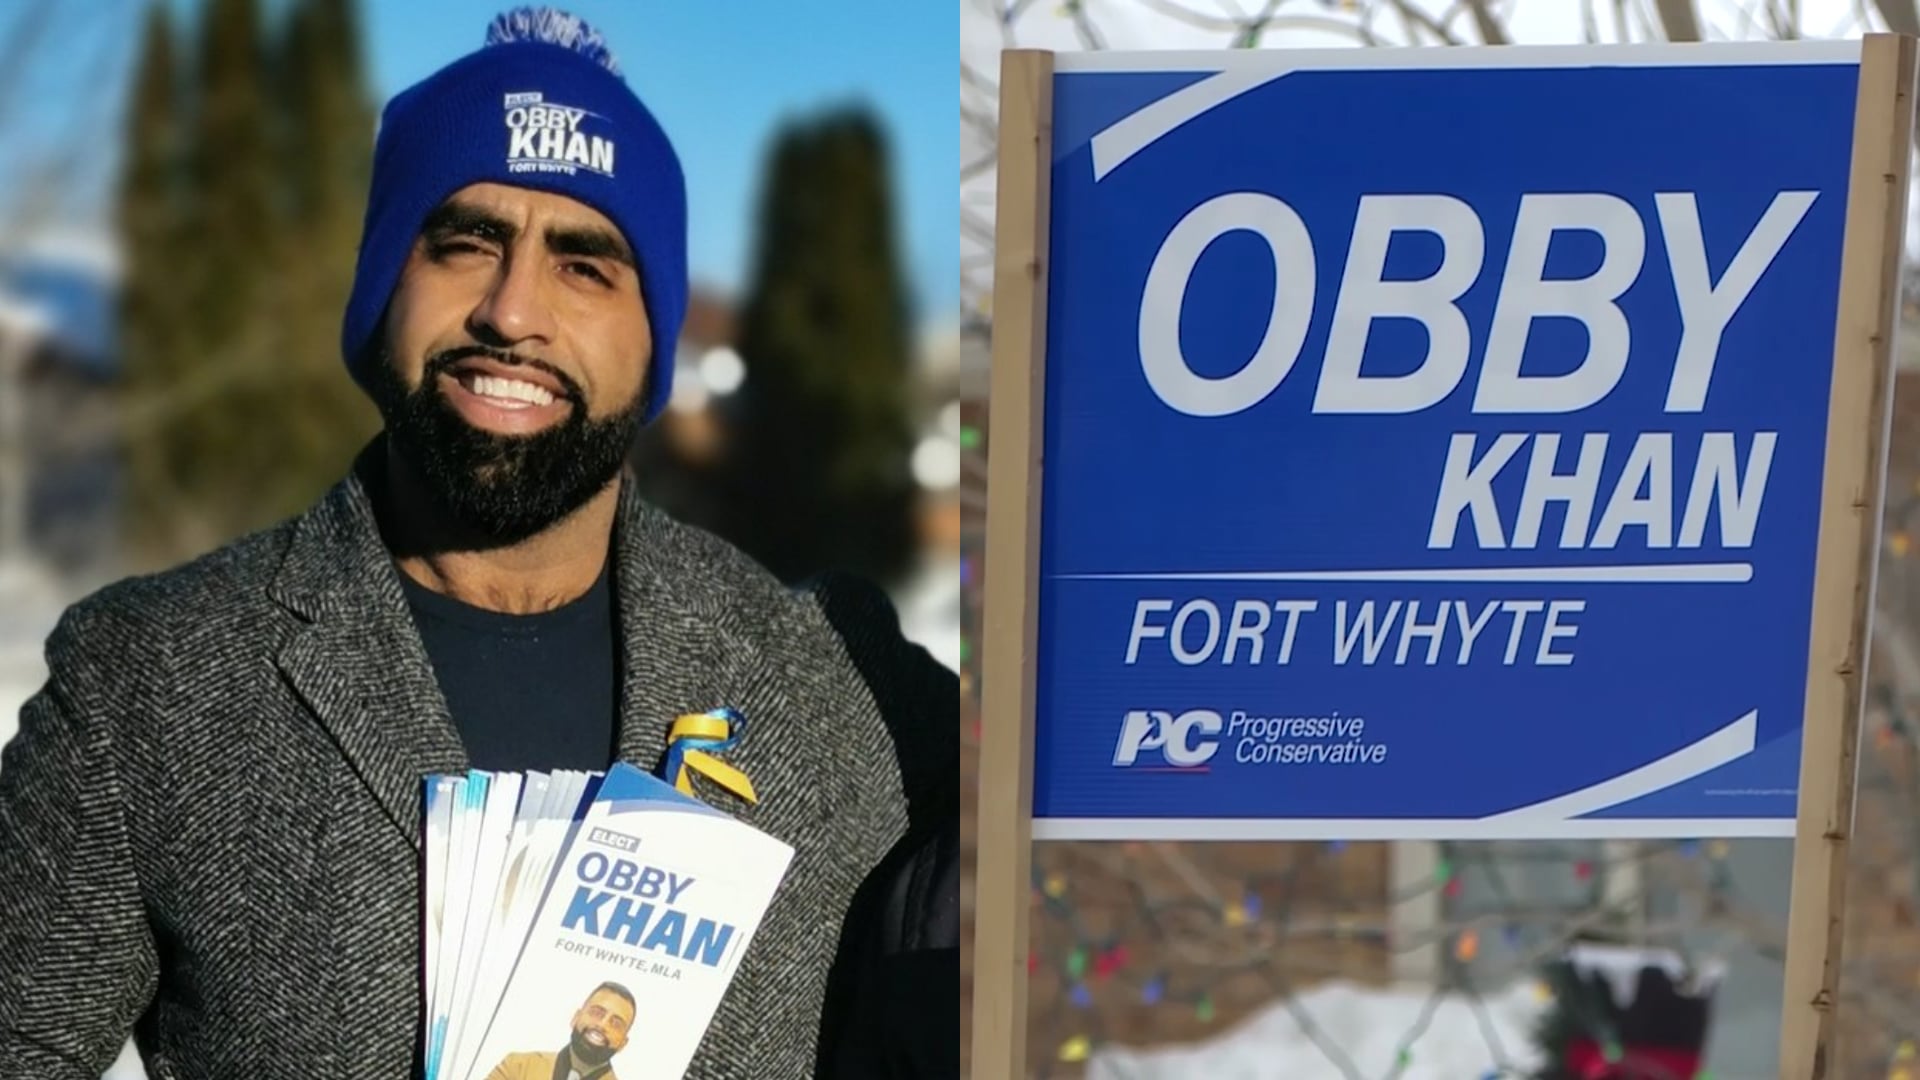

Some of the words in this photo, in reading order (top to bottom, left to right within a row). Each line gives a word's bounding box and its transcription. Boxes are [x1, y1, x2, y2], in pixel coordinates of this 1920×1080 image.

[506, 107, 585, 132] OBBY
[508, 128, 614, 174] KHAN
[1138, 191, 1821, 416] OBBY
[1427, 432, 1778, 549] KHAN
[1124, 598, 1318, 666] FORT
[1332, 598, 1586, 666] WHYTE
[1112, 710, 1223, 766] PC
[1227, 711, 1364, 741] Progressive
[1235, 738, 1387, 763] Conservative
[591, 830, 636, 849] ELECT
[576, 851, 696, 905] OBBY
[560, 885, 736, 968] KHAN
[555, 938, 595, 956] FORT
[595, 948, 649, 973] WHYTE,
[650, 964, 682, 981] MLA
